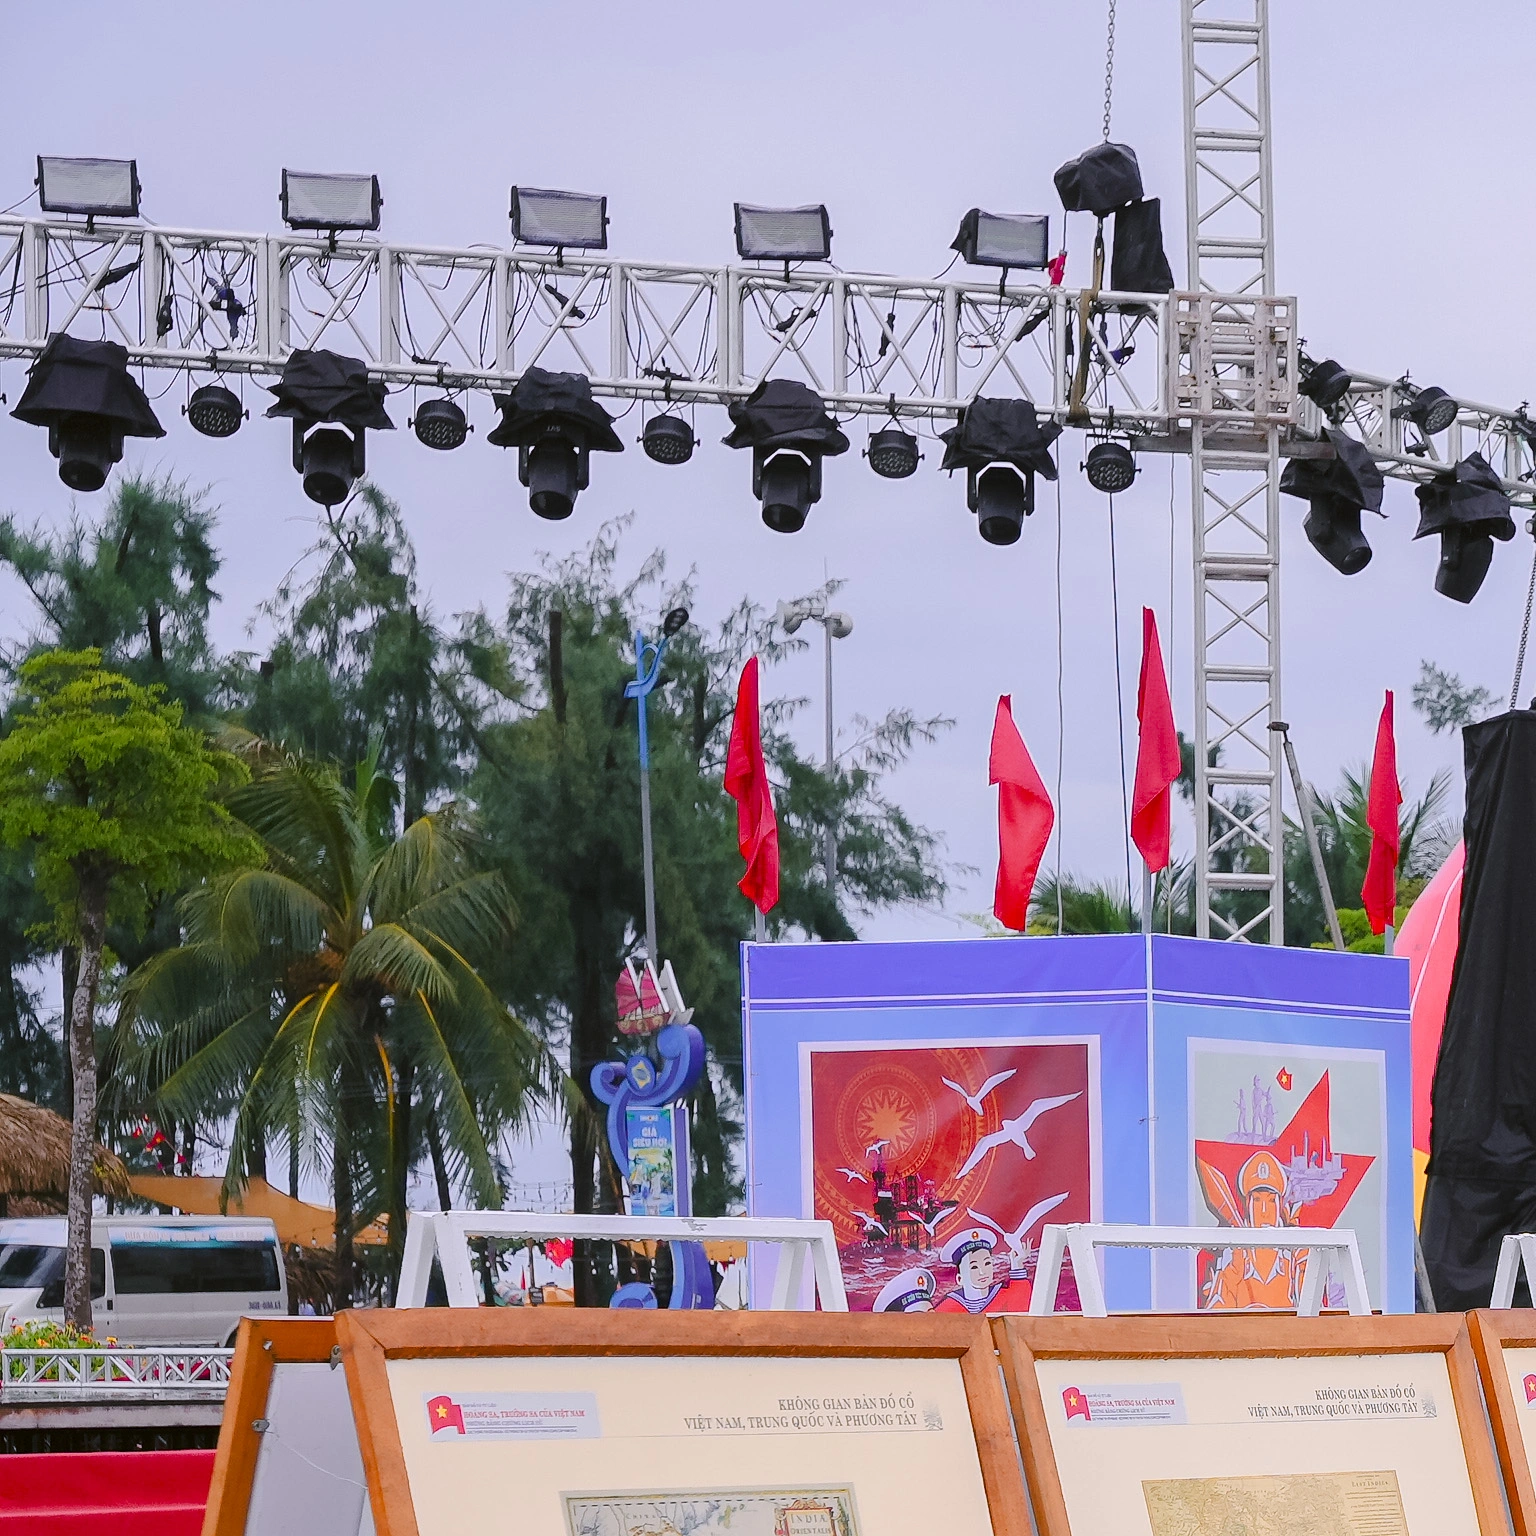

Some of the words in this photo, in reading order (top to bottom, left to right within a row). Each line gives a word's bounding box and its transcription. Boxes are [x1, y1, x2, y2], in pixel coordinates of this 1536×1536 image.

[778, 1396, 820, 1411] KHÔNG
[823, 1398, 850, 1410] GIAN
[899, 1391, 914, 1408] CỔ
[1315, 1387, 1347, 1400] KHÔNG
[1348, 1389, 1370, 1399] GIAN
[1403, 1383, 1416, 1398] CỔ
[1248, 1403, 1269, 1419] VIỆT
[1271, 1406, 1294, 1418] NAM,
[1294, 1405, 1325, 1416] TRUNG
[1326, 1400, 1350, 1417] QUỐC
[1351, 1401, 1365, 1414] VÀ
[1365, 1402, 1401, 1414] PHƯƠNG
[1402, 1399, 1418, 1413] TÂY
[684, 1414, 712, 1432] VIỆT
[716, 1417, 746, 1431] NAM,
[747, 1416, 789, 1429] TRUNG
[792, 1411, 824, 1430] QUỐC
[826, 1412, 843, 1427] VÀ
[845, 1414, 894, 1427] PHƯƠNG
[895, 1410, 917, 1425] TÂY
